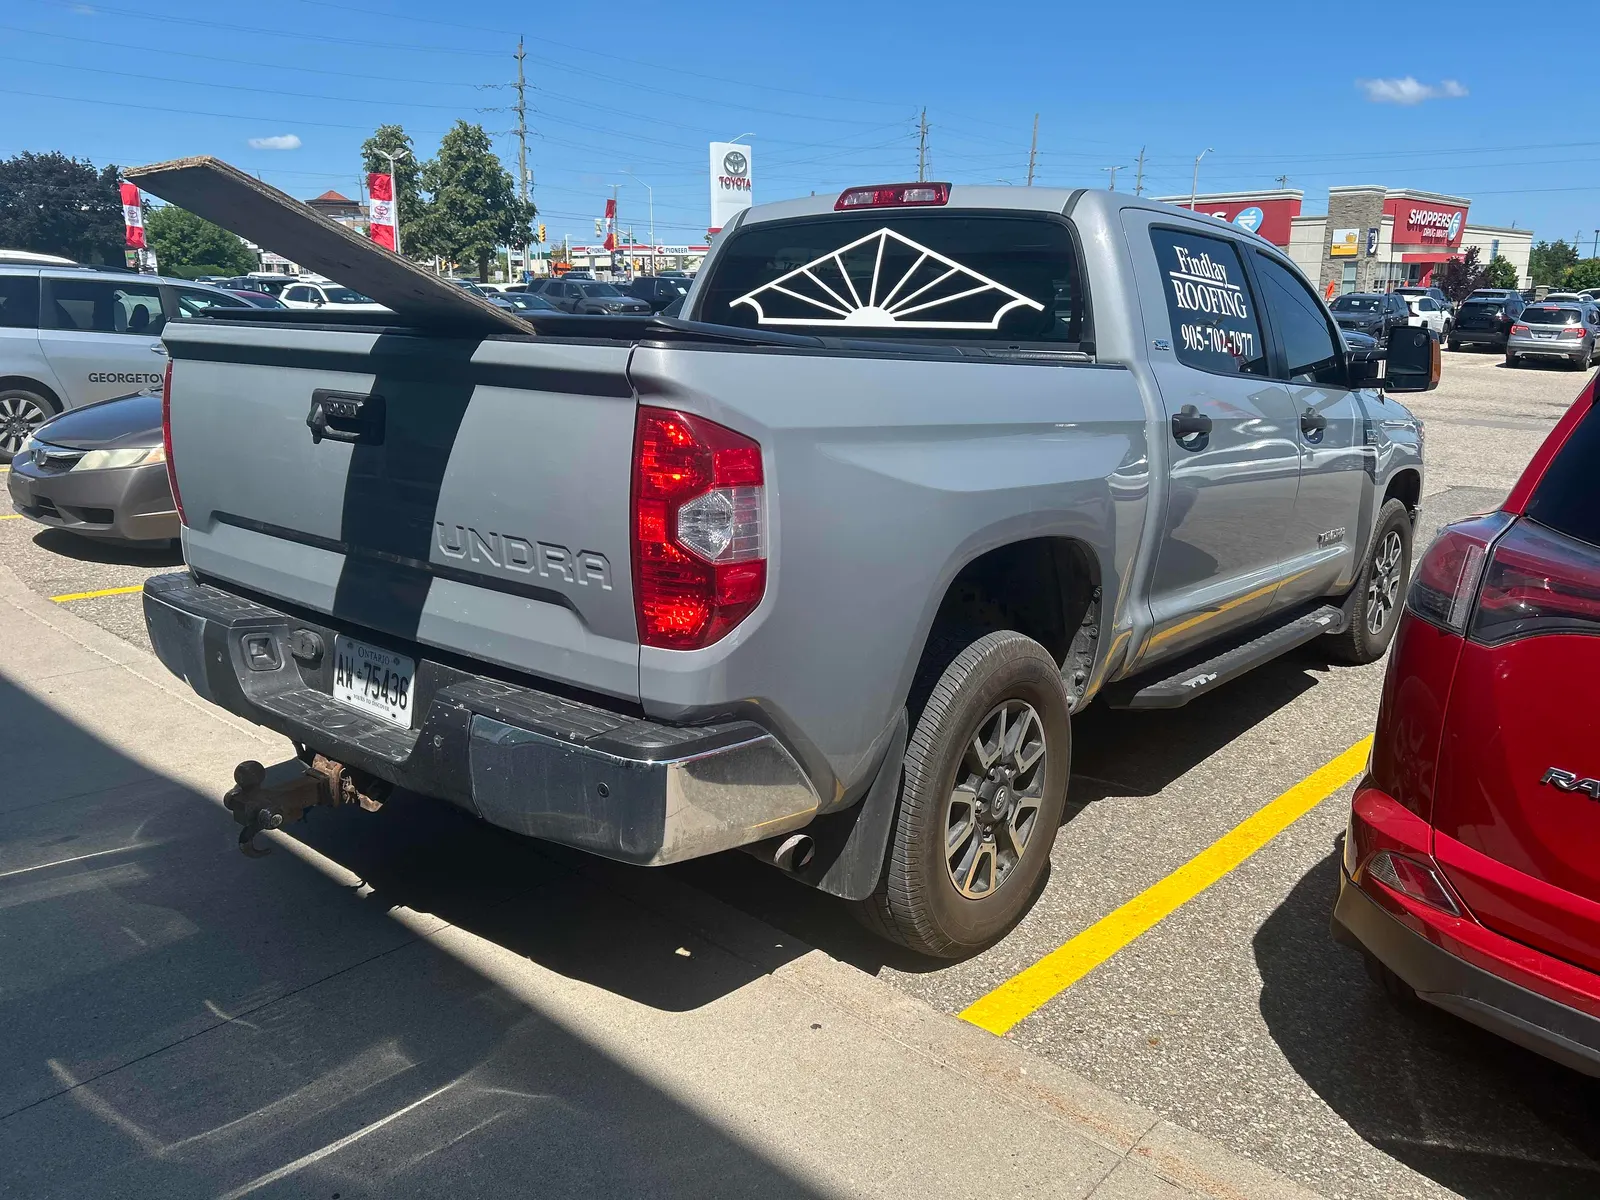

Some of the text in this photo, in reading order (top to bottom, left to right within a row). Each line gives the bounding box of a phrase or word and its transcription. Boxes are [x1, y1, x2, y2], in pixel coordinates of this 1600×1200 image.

[718, 176, 751, 190] TOYOTA
[1408, 209, 1452, 228] SHOPPERS
[1423, 228, 1436, 237] DRUG
[1173, 245, 1228, 288] Findlay
[1171, 279, 1247, 318] ROOFING
[1181, 323, 1253, 356] 905-702-7977
[88, 372, 164, 384] GEORGETO
[408, 517, 613, 591] UNDRA
[358, 646, 390, 666] ONTARIO
[364, 661, 409, 710] 75436
[1540, 766, 1600, 799] RA
